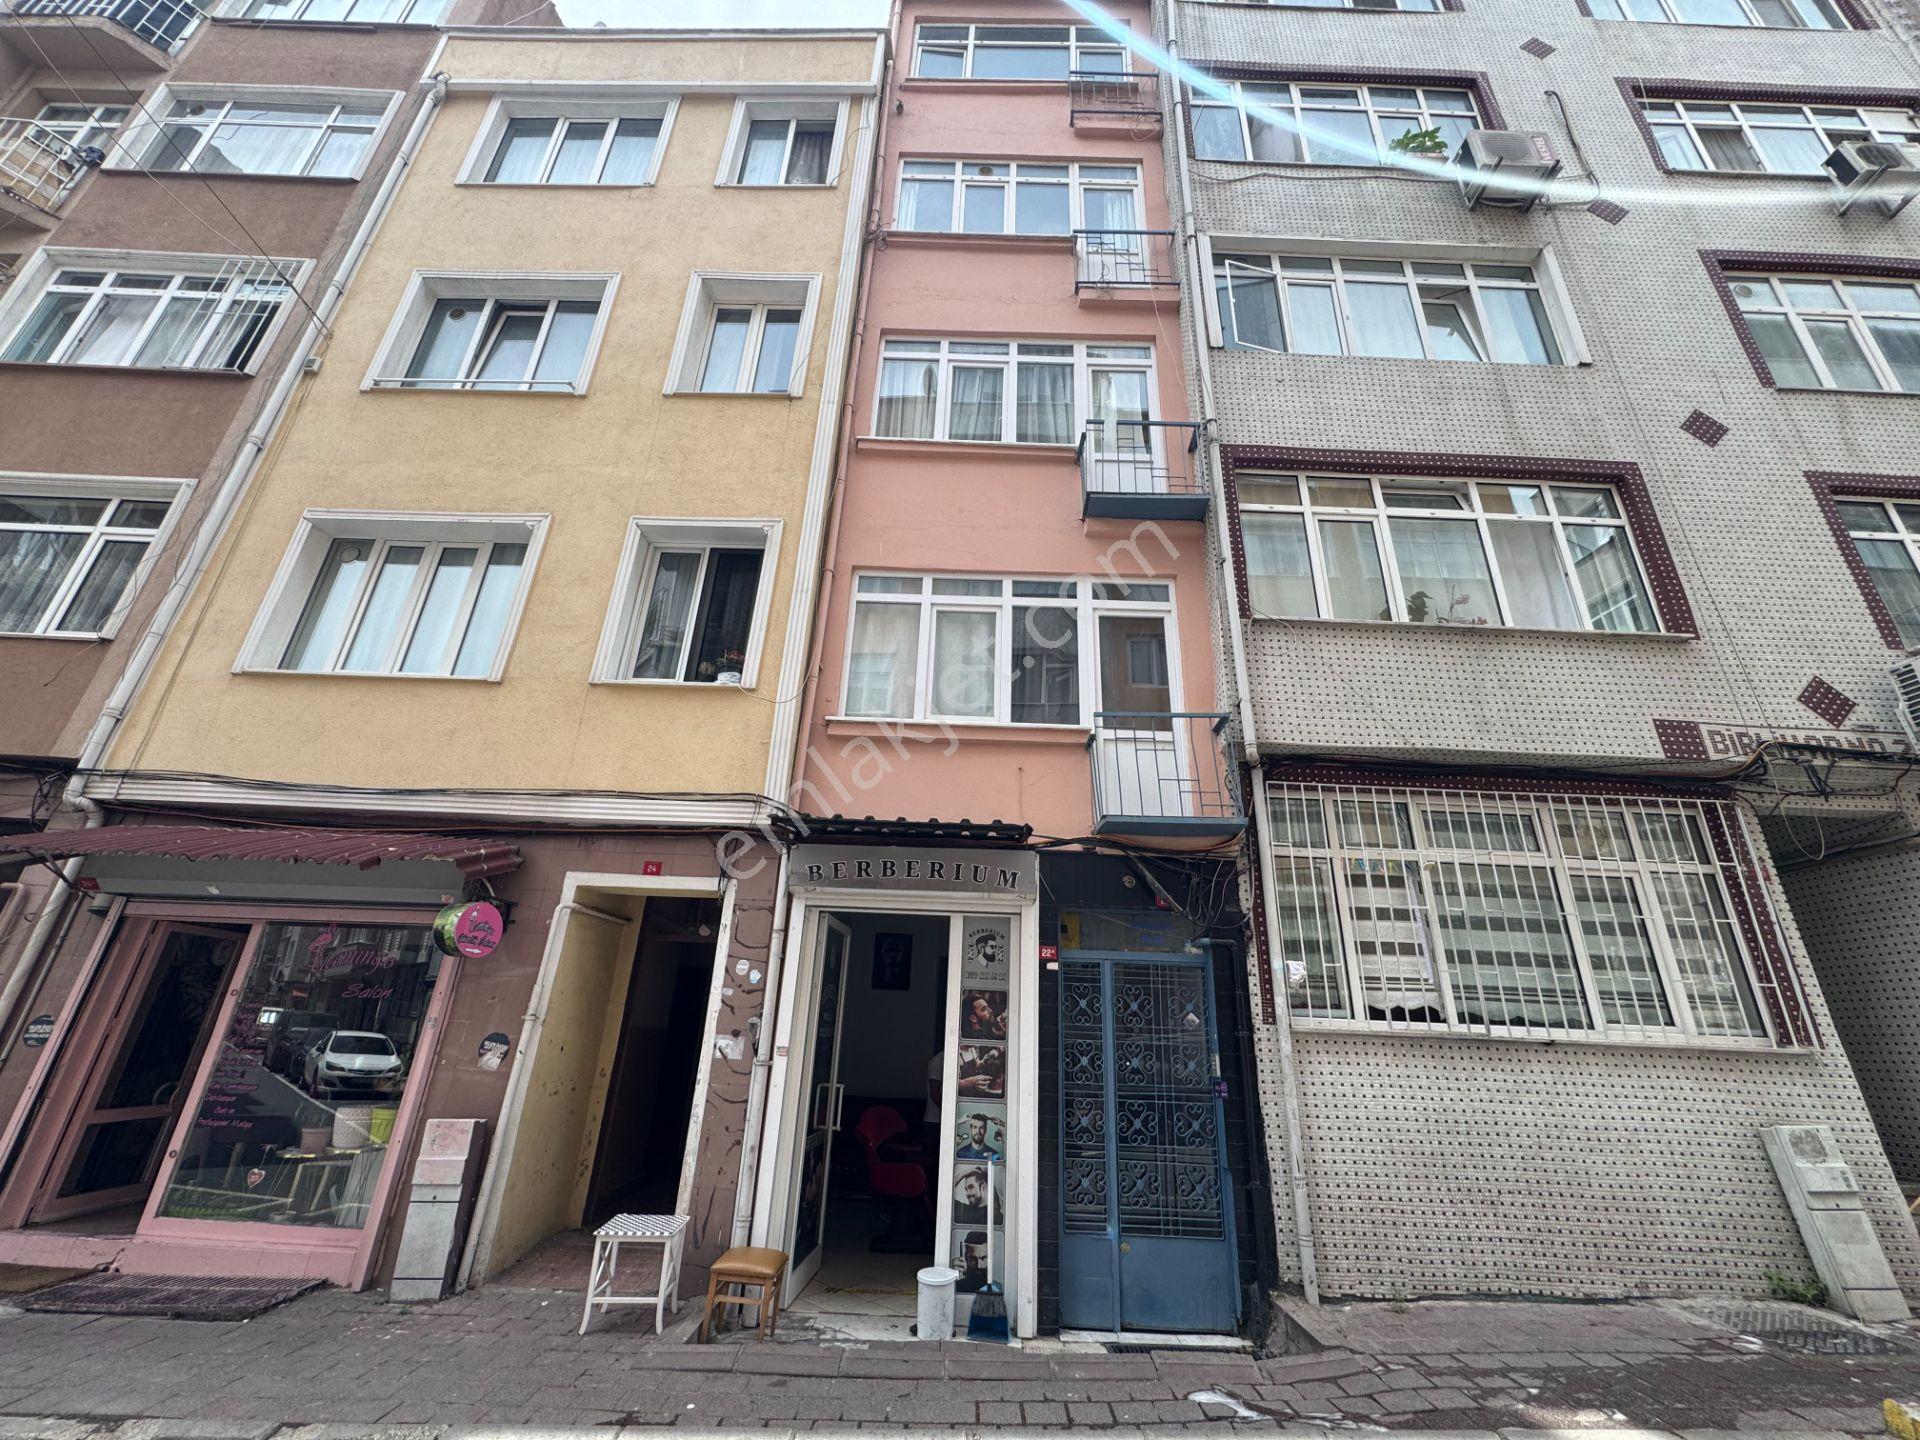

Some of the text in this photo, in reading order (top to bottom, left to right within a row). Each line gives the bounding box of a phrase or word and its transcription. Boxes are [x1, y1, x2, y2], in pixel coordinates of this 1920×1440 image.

[805, 859, 1020, 890] BERBERIUM
[968, 927, 1006, 940] BERBERIUM
[341, 983, 394, 999] Salon
